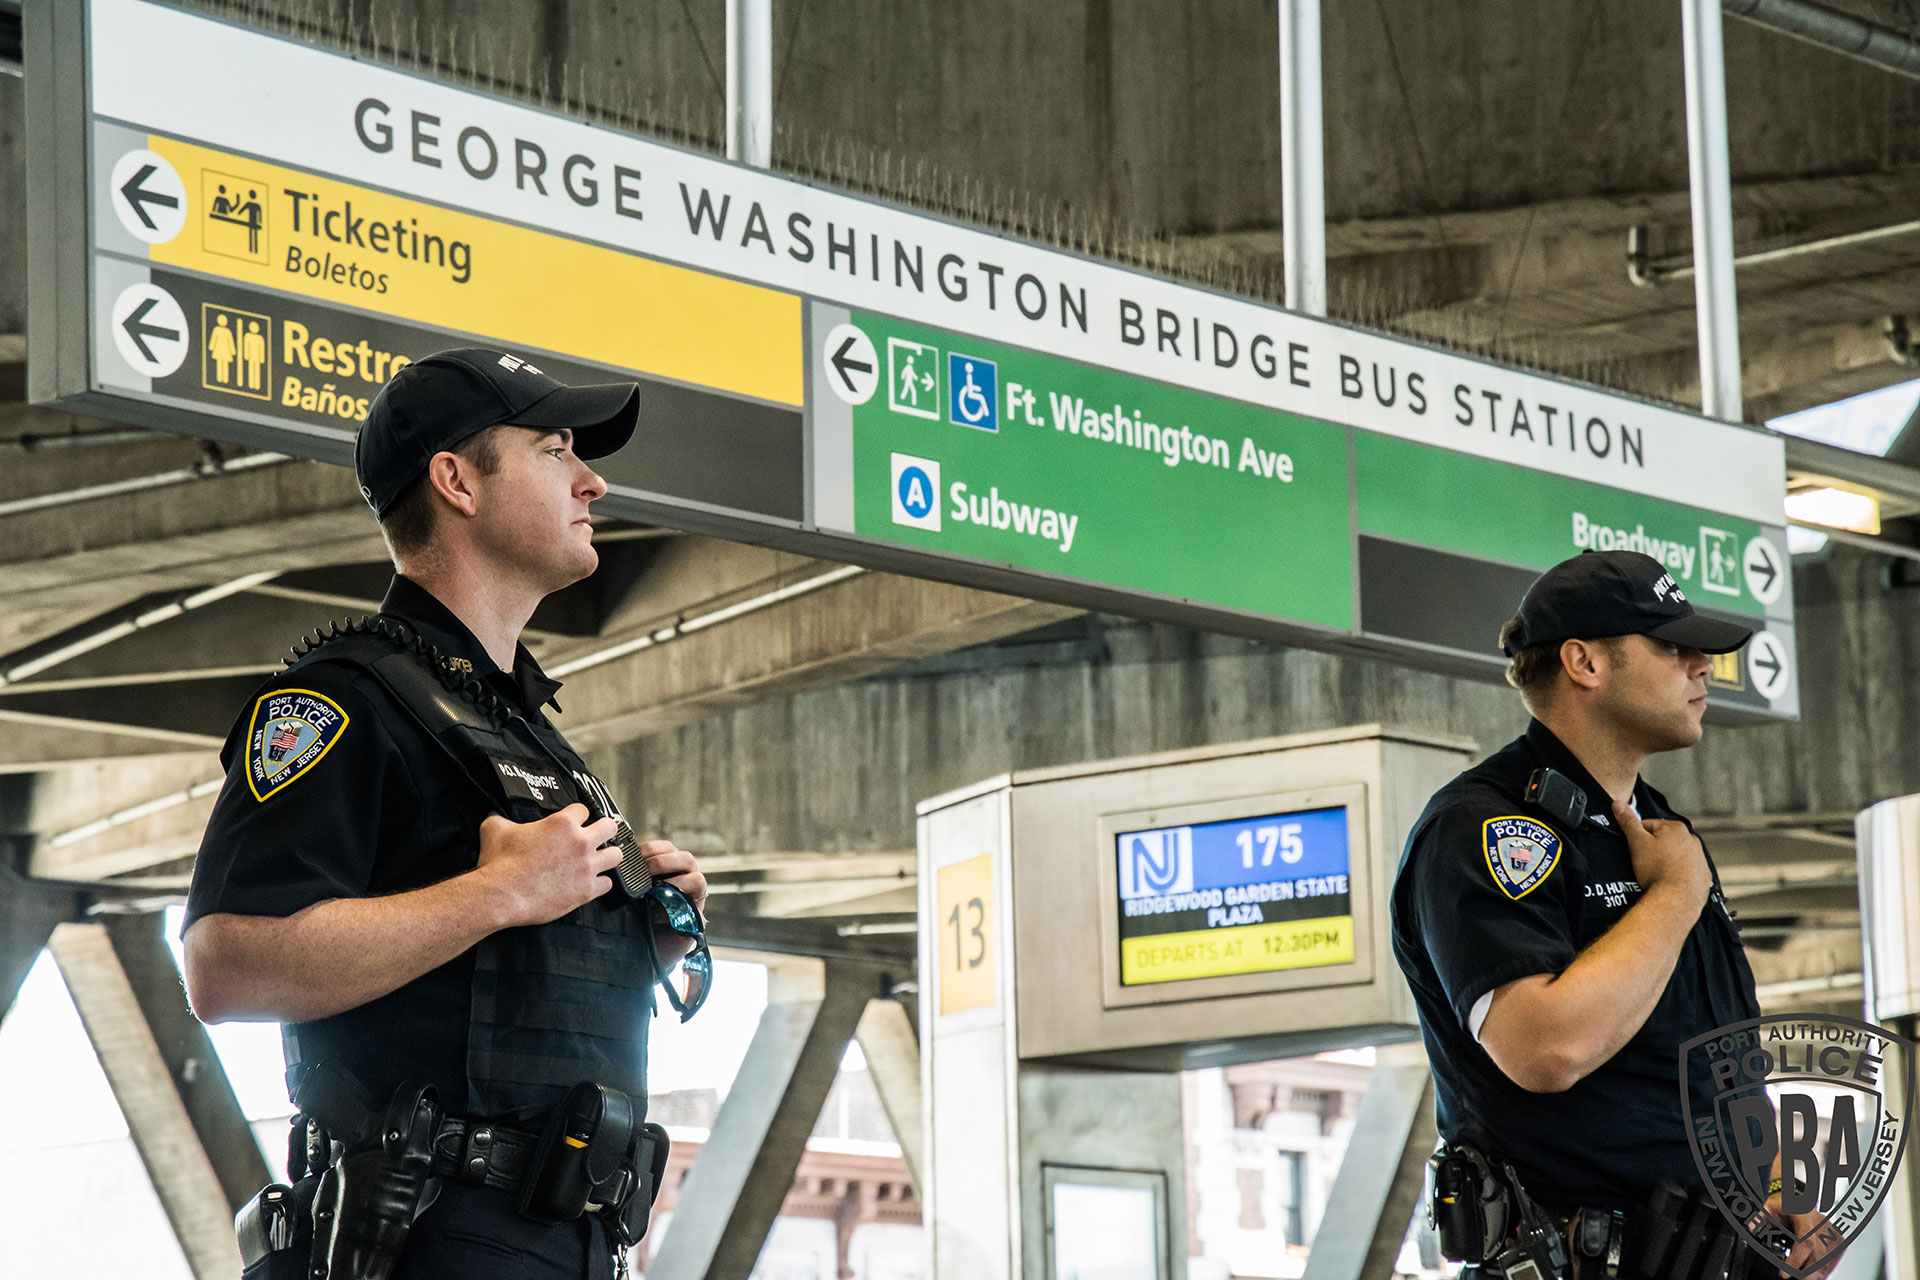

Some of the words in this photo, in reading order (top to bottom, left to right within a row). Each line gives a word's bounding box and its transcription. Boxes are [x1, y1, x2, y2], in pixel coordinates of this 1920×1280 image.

[283, 187, 472, 283] Ticketing
[285, 245, 388, 294] Boletos
[354, 98, 643, 220] GEORGE
[678, 182, 1089, 333] WASHINGTON
[1120, 299, 1311, 389] BRIDGE
[1339, 354, 1427, 415] BUS
[1454, 384, 1645, 467] STATION
[284, 320, 413, 384] Restro
[282, 376, 369, 421] Baños
[1006, 381, 1044, 428] Ft.
[1049, 391, 1230, 468] Washington
[1238, 435, 1294, 483] Ave
[906, 476, 927, 510] A
[950, 481, 1078, 553] Subway
[1572, 512, 1696, 580] Broadway
[269, 696, 293, 708] PORT
[295, 697, 339, 721] AUTHORITY
[269, 704, 332, 731] POLICE
[253, 729, 264, 750] NEW
[253, 756, 265, 782] YORK
[270, 767, 292, 785] NEW
[296, 739, 325, 768] JERSEY
[1236, 823, 1304, 869] 175
[1491, 820, 1513, 830] PORT
[1515, 820, 1556, 842] AUTHORITY
[1494, 825, 1553, 848] POLICE
[1489, 846, 1500, 863] NEW
[1495, 865, 1510, 885] YORK
[1519, 875, 1537, 891] NEW
[1535, 854, 1553, 878] JERSEY
[1124, 891, 1223, 917] RIDGEWOOD
[1224, 881, 1294, 907] GARDEN
[1295, 875, 1349, 899] STATE
[1595, 883, 1607, 896] D.
[1606, 881, 1642, 895] HUNTE
[1604, 894, 1628, 908] 3101
[946, 897, 986, 972] 13
[1207, 904, 1264, 928] PLAZA
[1137, 942, 1217, 968] DEPARTS
[1224, 939, 1244, 958] AT
[1264, 930, 1340, 955] 12:30PM
